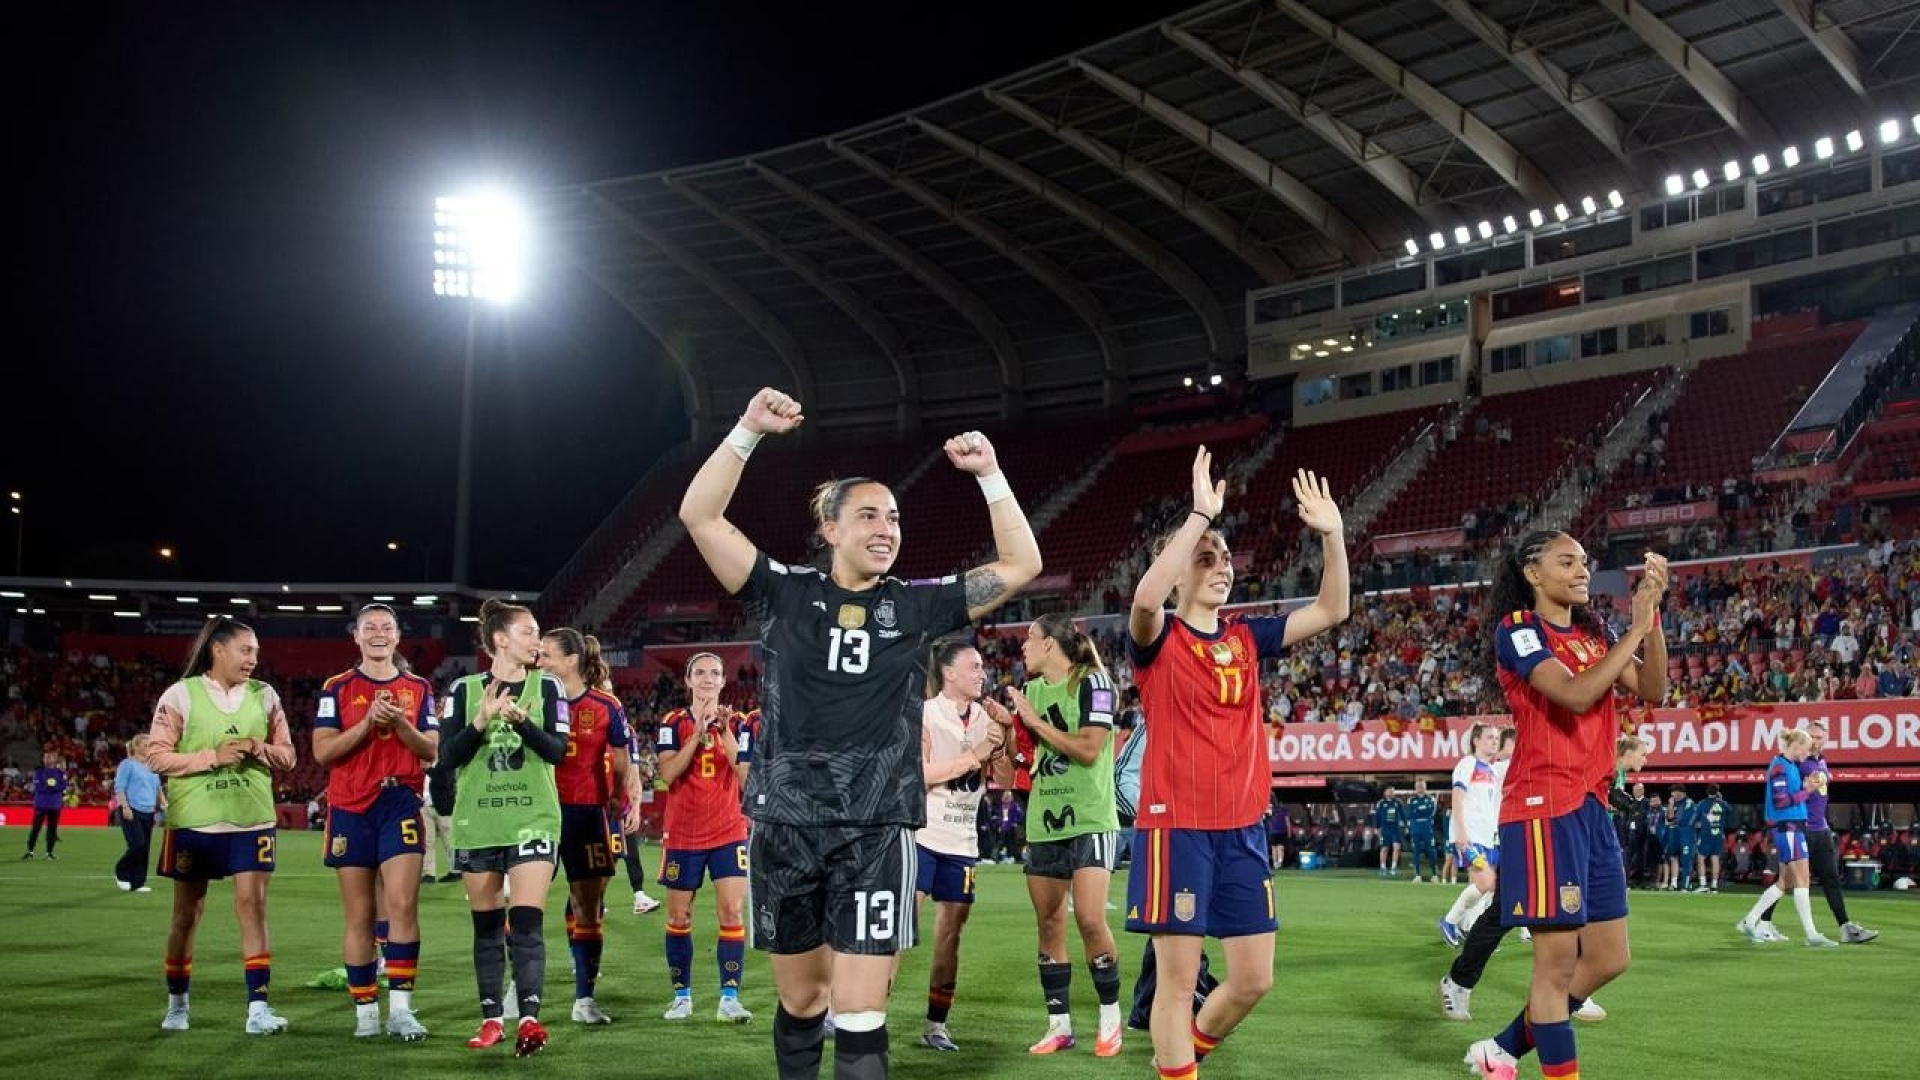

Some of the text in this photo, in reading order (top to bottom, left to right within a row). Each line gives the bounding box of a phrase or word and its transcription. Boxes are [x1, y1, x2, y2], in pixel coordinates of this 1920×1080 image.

[1628, 504, 1695, 525] EBRO
[827, 627, 870, 675] 13
[1215, 666, 1242, 704] 17
[1361, 731, 1423, 761] SON
[1622, 719, 1740, 754] STADI
[701, 753, 716, 778] 6
[477, 795, 534, 808] EBRO
[401, 818, 418, 846] 5
[518, 829, 552, 856] 23
[584, 842, 607, 870] 15
[736, 845, 748, 870] 6
[854, 890, 895, 941] 13
